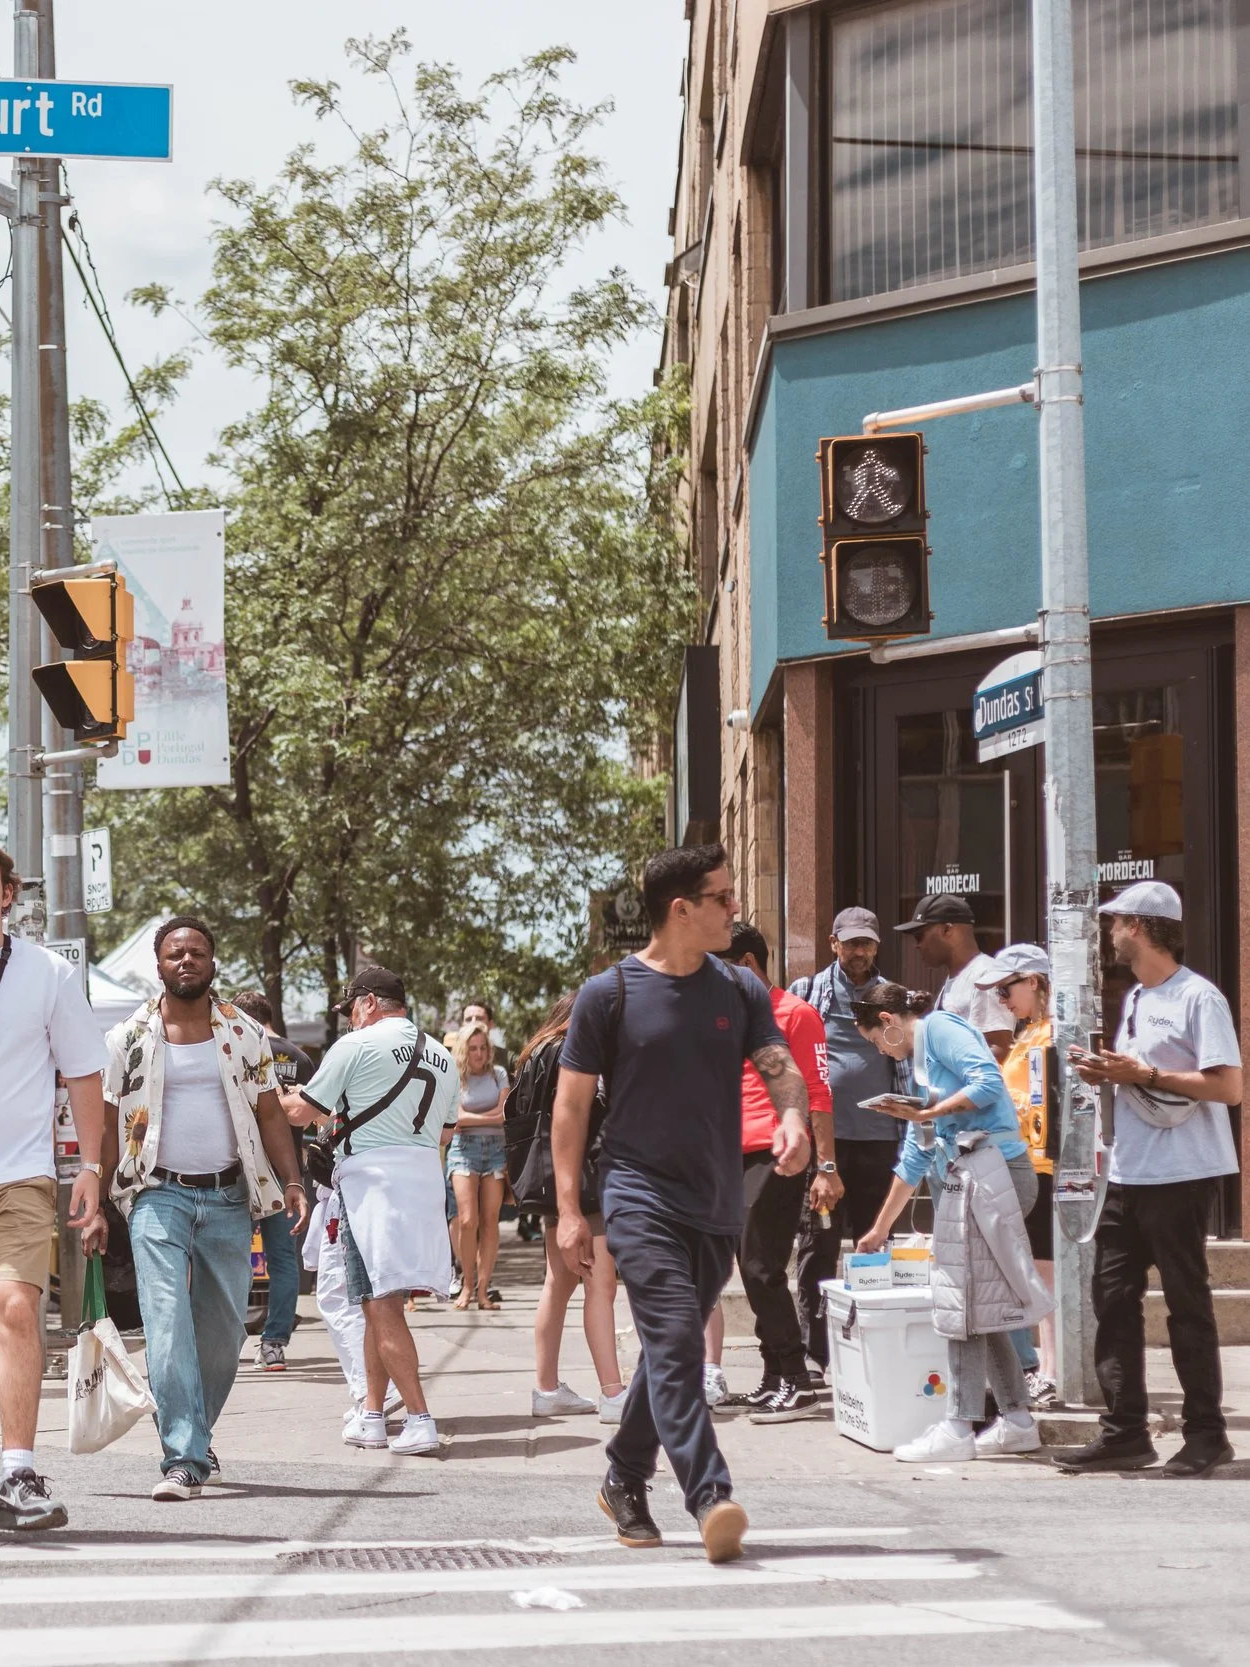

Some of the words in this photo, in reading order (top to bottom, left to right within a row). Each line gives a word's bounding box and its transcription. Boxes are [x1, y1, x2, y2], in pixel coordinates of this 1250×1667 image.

[71, 91, 103, 119] Rd
[979, 688, 1020, 727] Dundas
[1025, 686, 1034, 712] St
[157, 730, 187, 742] Little
[1007, 727, 1027, 749] 1272
[157, 740, 205, 755] Portugal
[157, 752, 203, 766] Dundas
[1097, 859, 1154, 882] MORDECAI
[87, 882, 108, 895] SNOW
[926, 873, 980, 895] MORDECAI
[87, 896, 109, 909] ROUTE
[837, 1388, 865, 1417] Wellbeing
[844, 1410, 856, 1428] One
